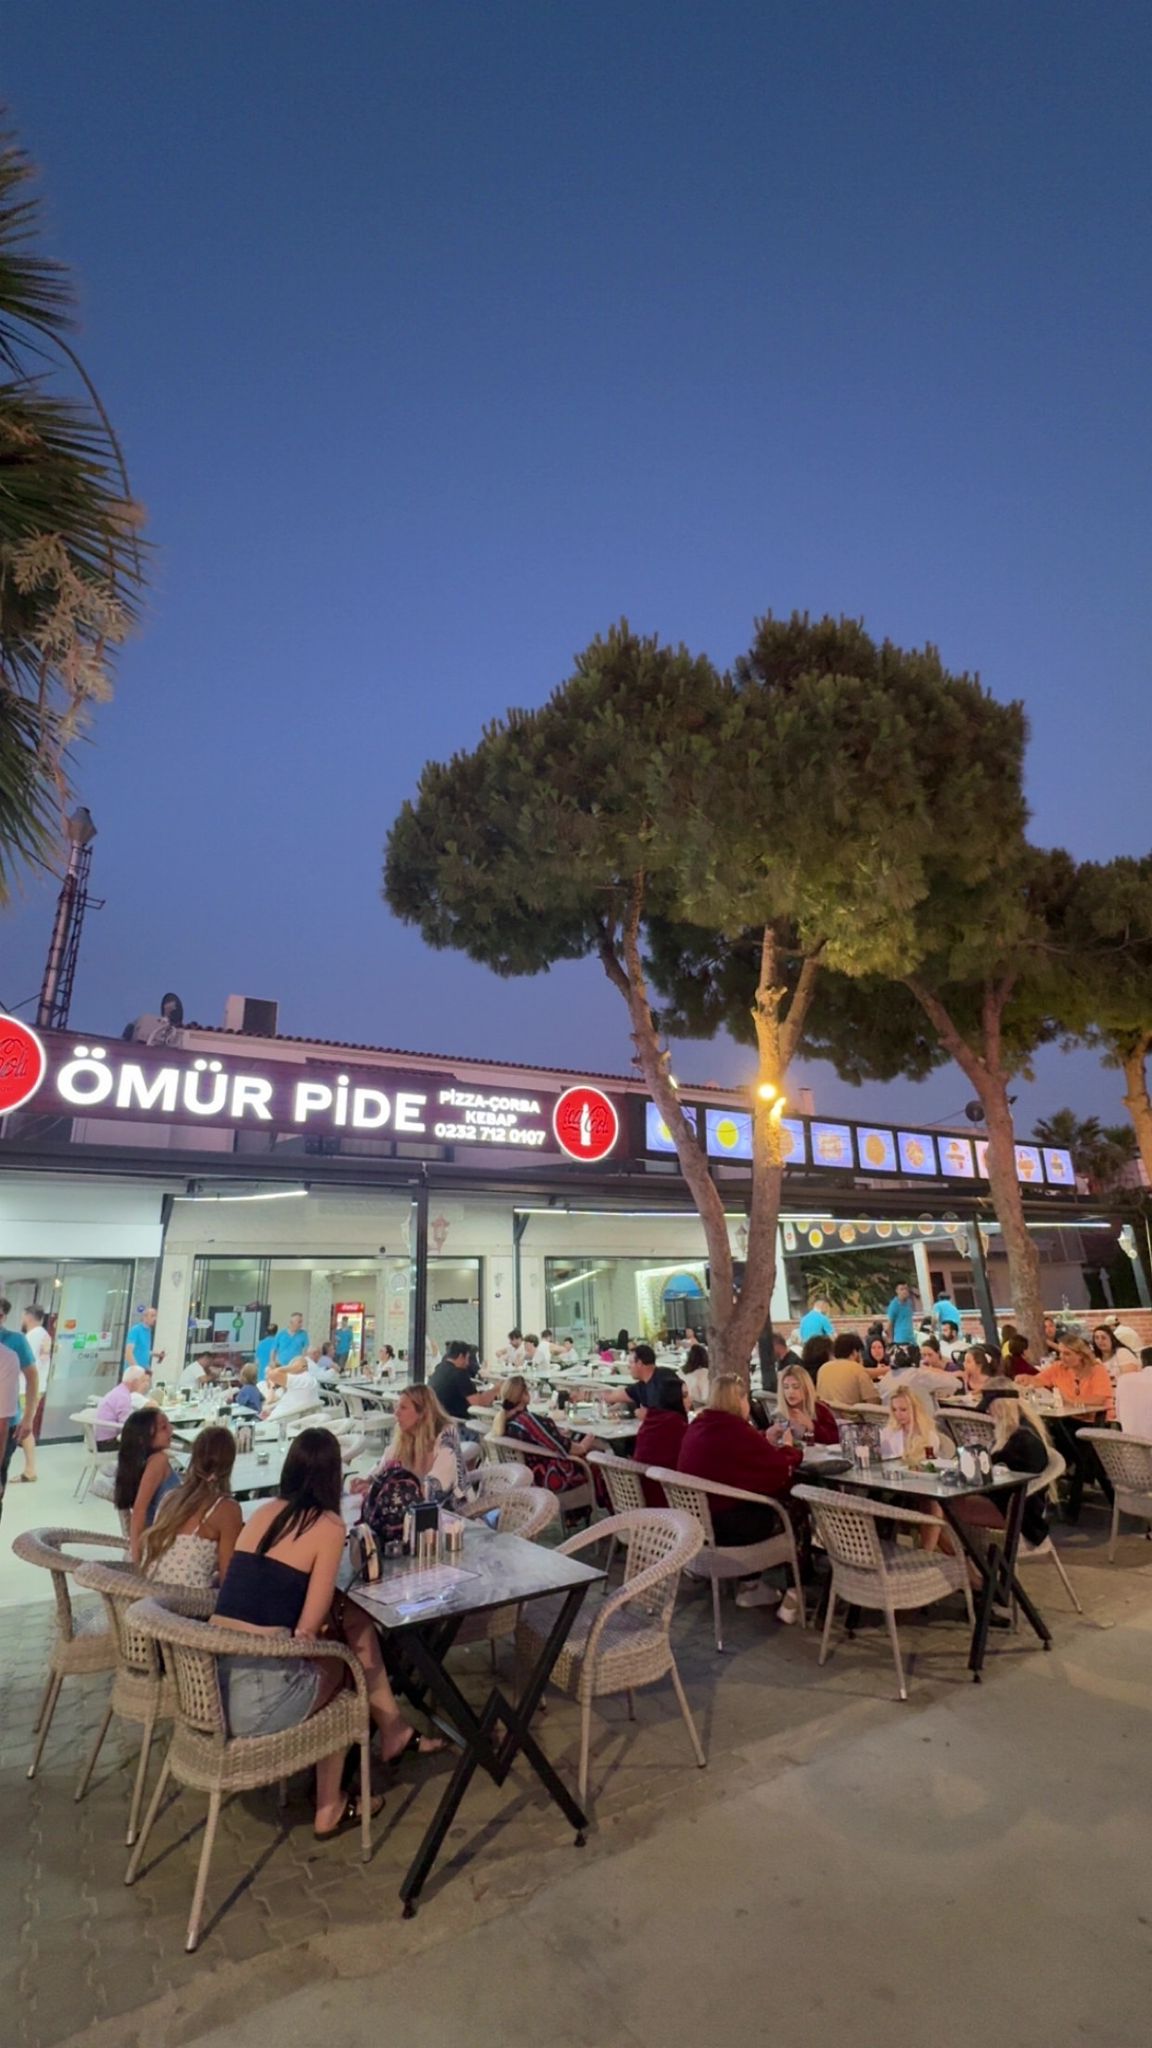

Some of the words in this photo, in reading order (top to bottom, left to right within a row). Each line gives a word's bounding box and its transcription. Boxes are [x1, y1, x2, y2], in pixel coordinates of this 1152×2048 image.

[57, 1046, 273, 1120] ÖMÜR
[294, 1075, 426, 1132] PİDE
[465, 1110, 518, 1127] KEBAP
[434, 1123, 477, 1140] 0232
[479, 1126, 507, 1142] 712
[509, 1129, 546, 1146] 0107
